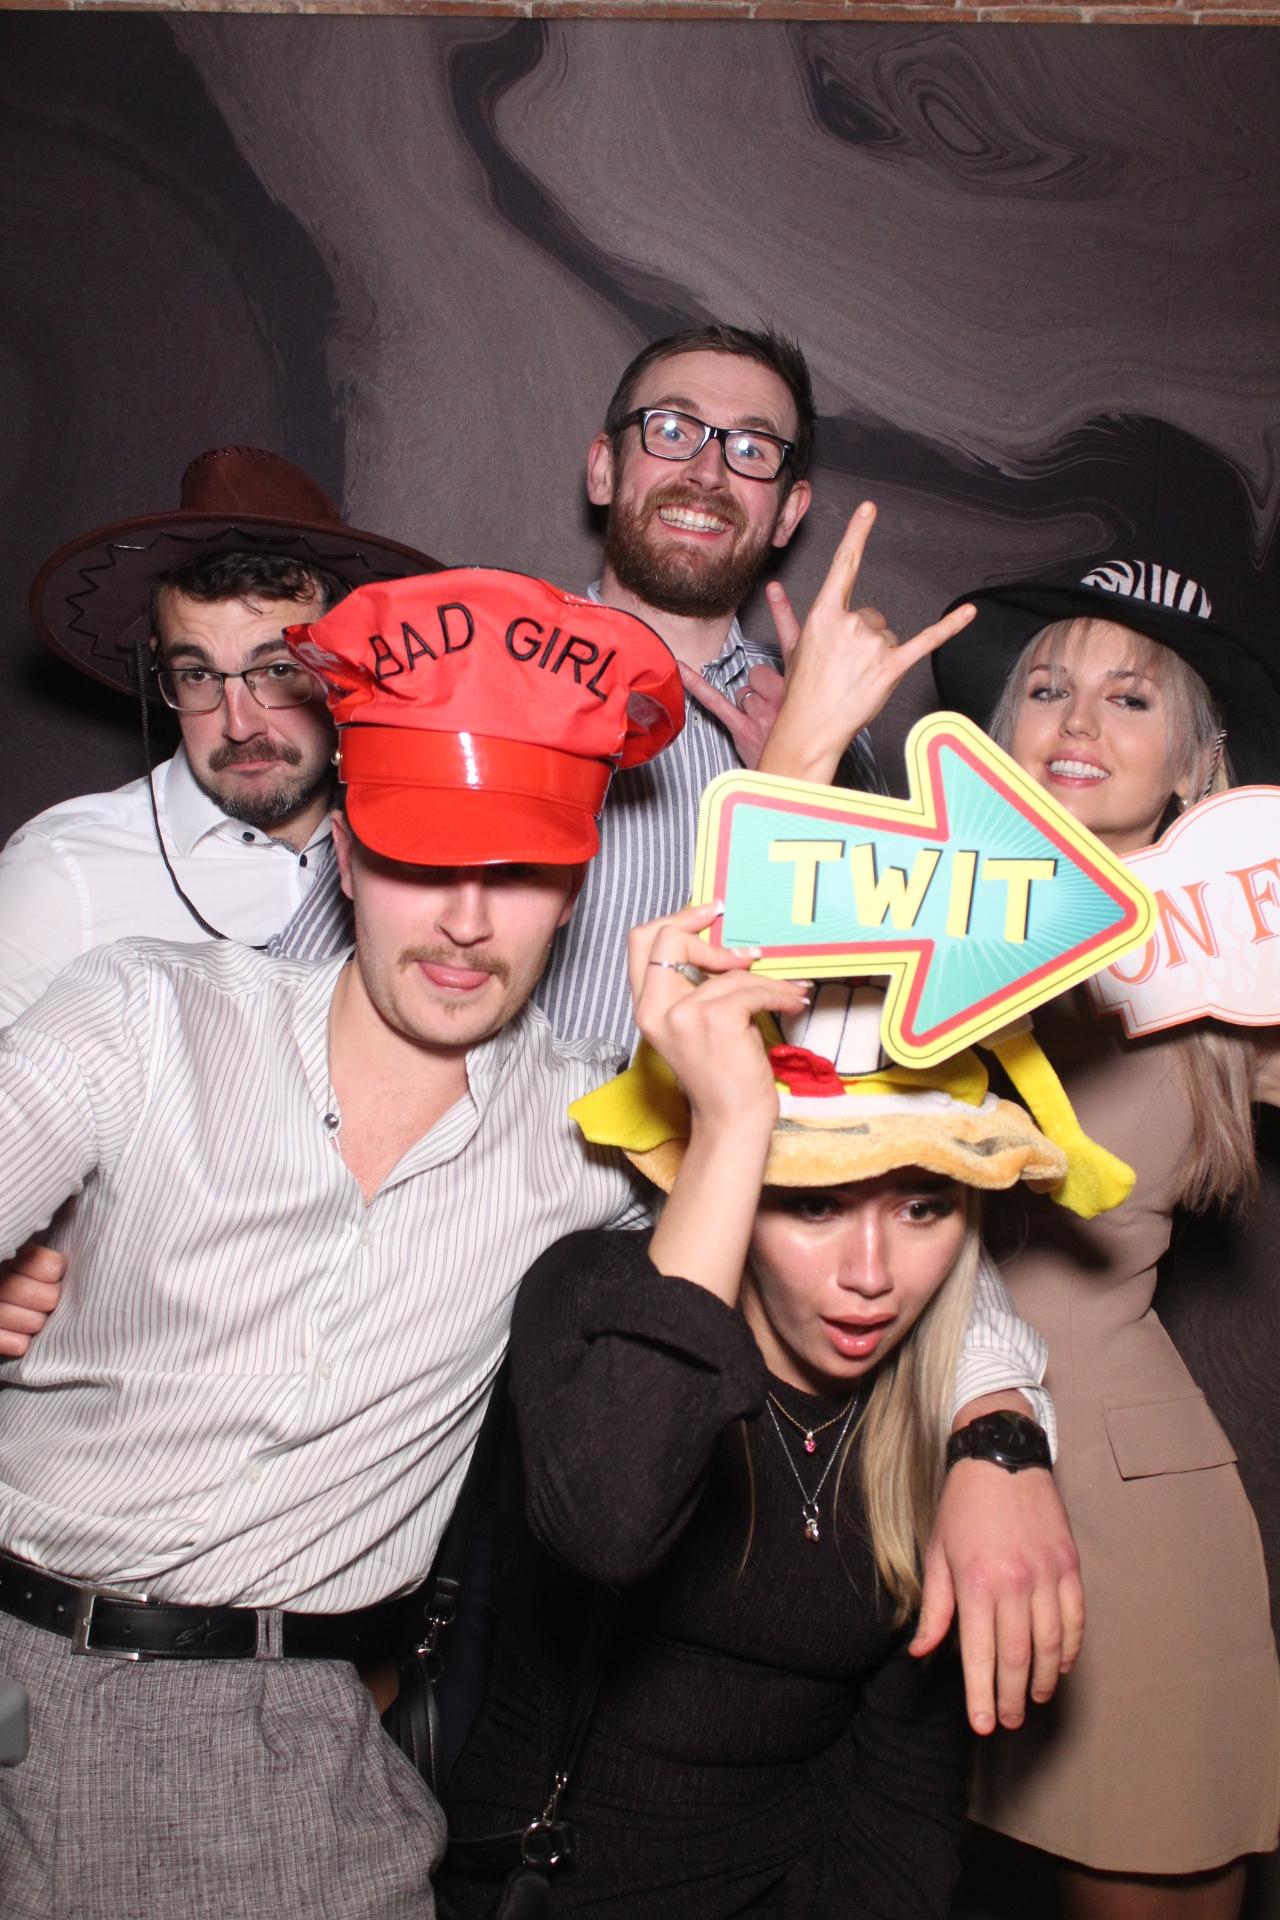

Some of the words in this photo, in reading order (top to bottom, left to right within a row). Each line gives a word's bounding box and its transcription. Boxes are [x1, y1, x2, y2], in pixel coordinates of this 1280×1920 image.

[369, 602, 474, 680] BAD
[505, 617, 616, 702] GIRL
[768, 839, 1057, 944] TWIT
